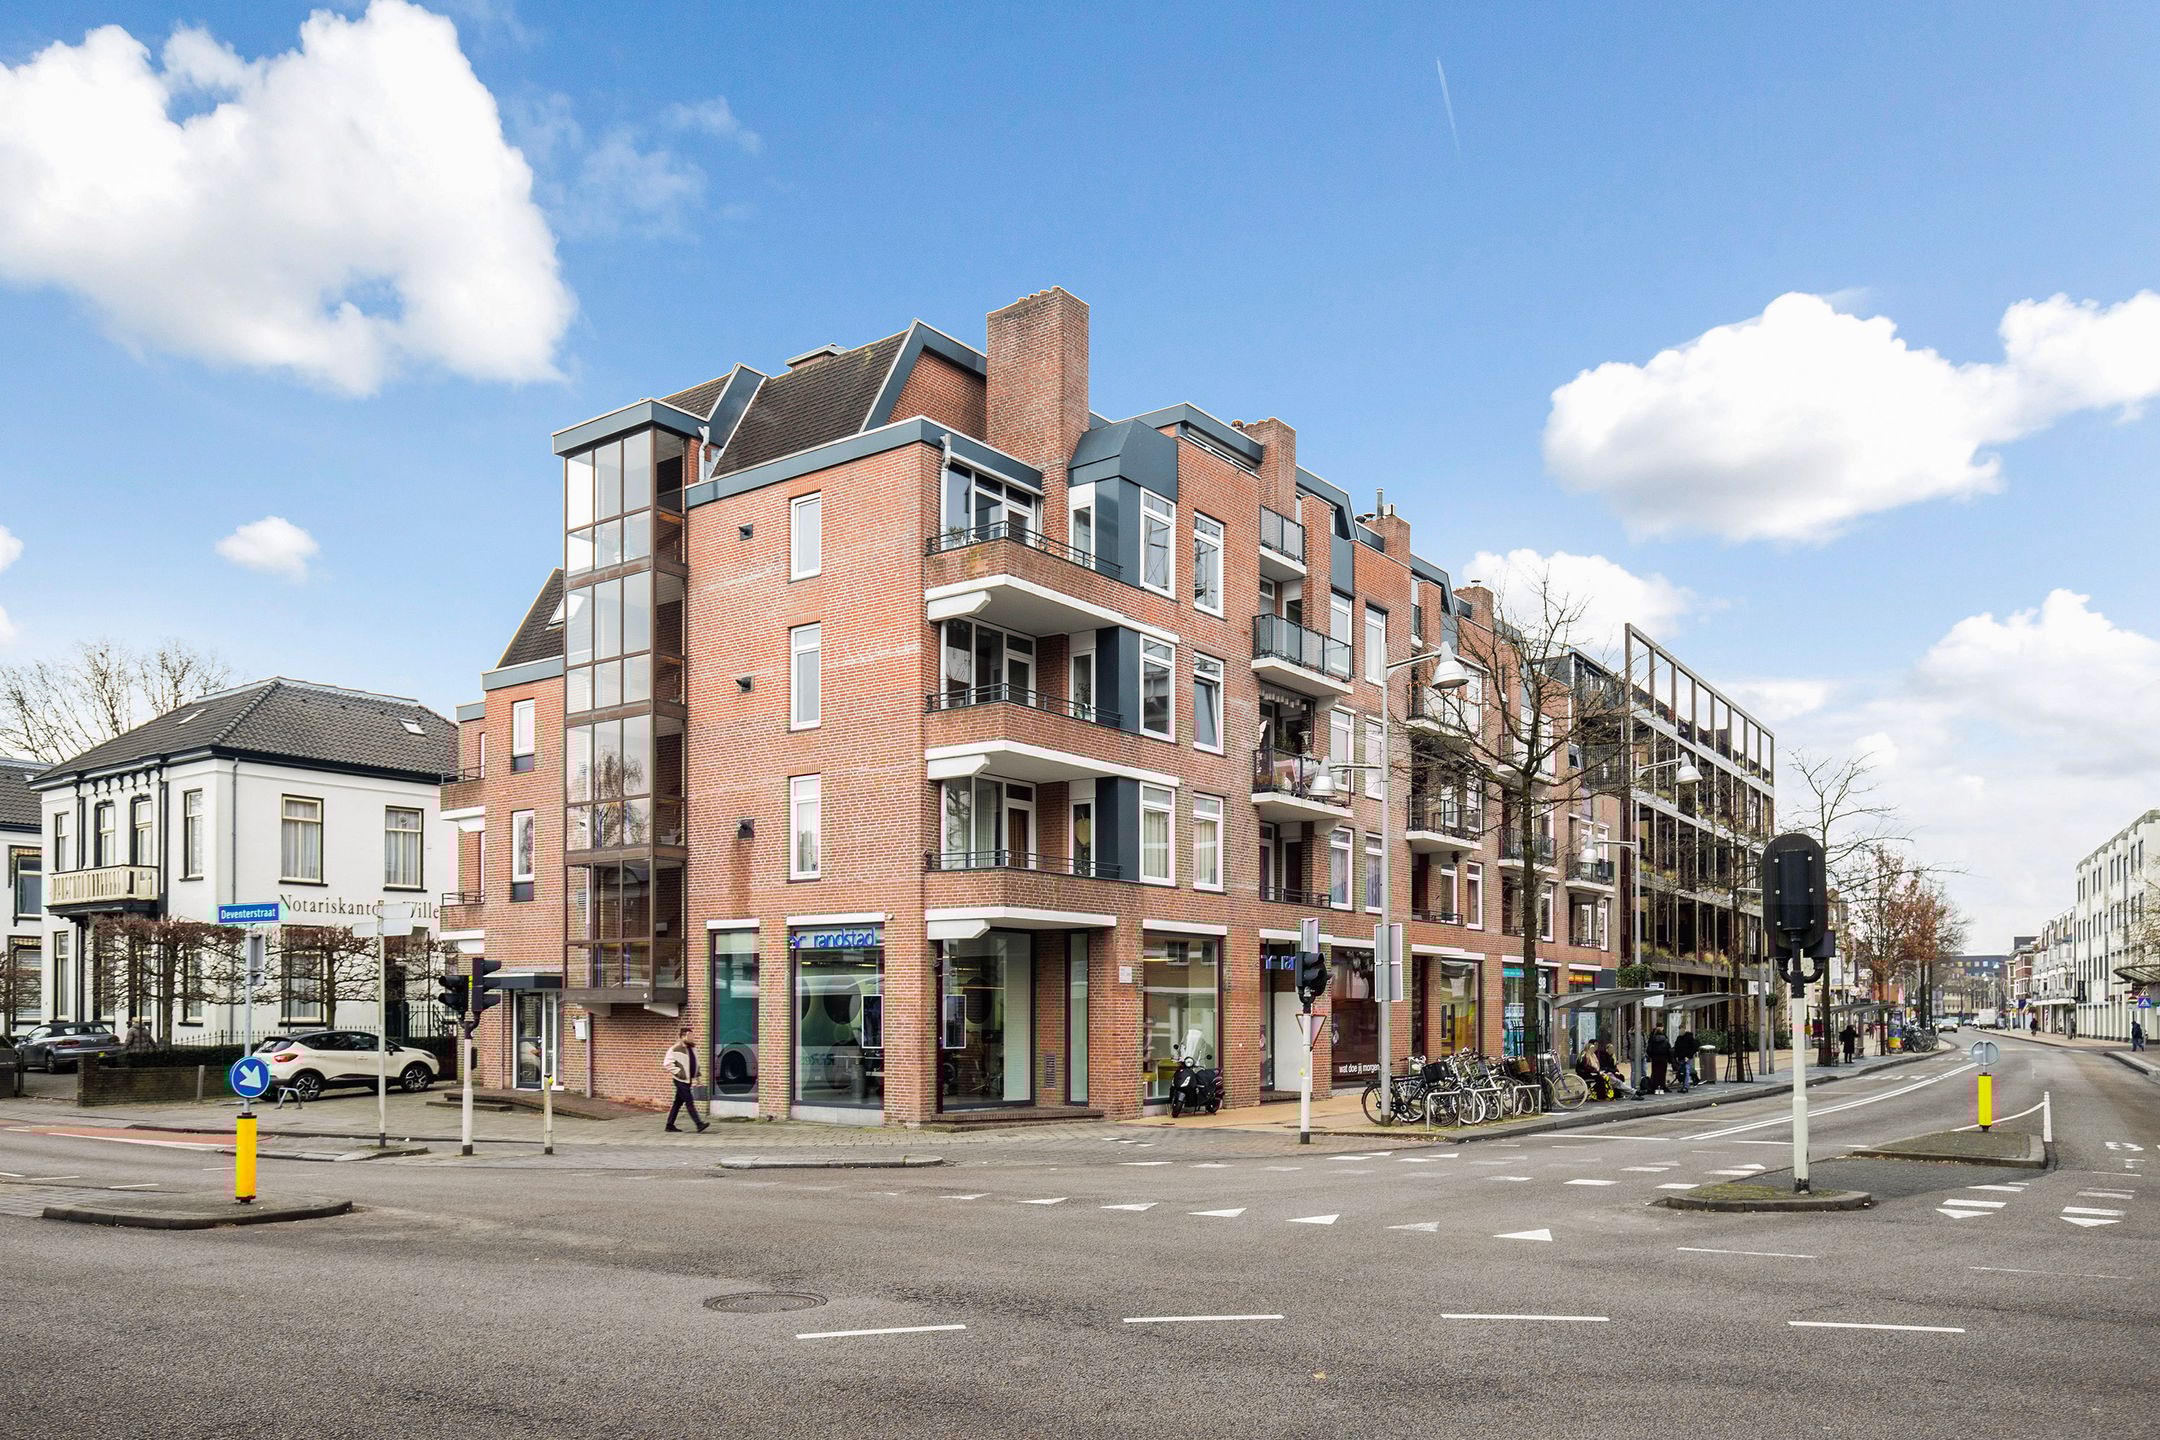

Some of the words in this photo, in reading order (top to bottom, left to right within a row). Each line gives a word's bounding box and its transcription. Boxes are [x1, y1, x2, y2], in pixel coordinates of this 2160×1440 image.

[221, 907, 276, 920] Deventerstraat
[280, 893, 380, 917] Notariskanto
[814, 928, 875, 949] randstad
[1339, 1064, 1348, 1073] wat
[1348, 1063, 1357, 1073] doe
